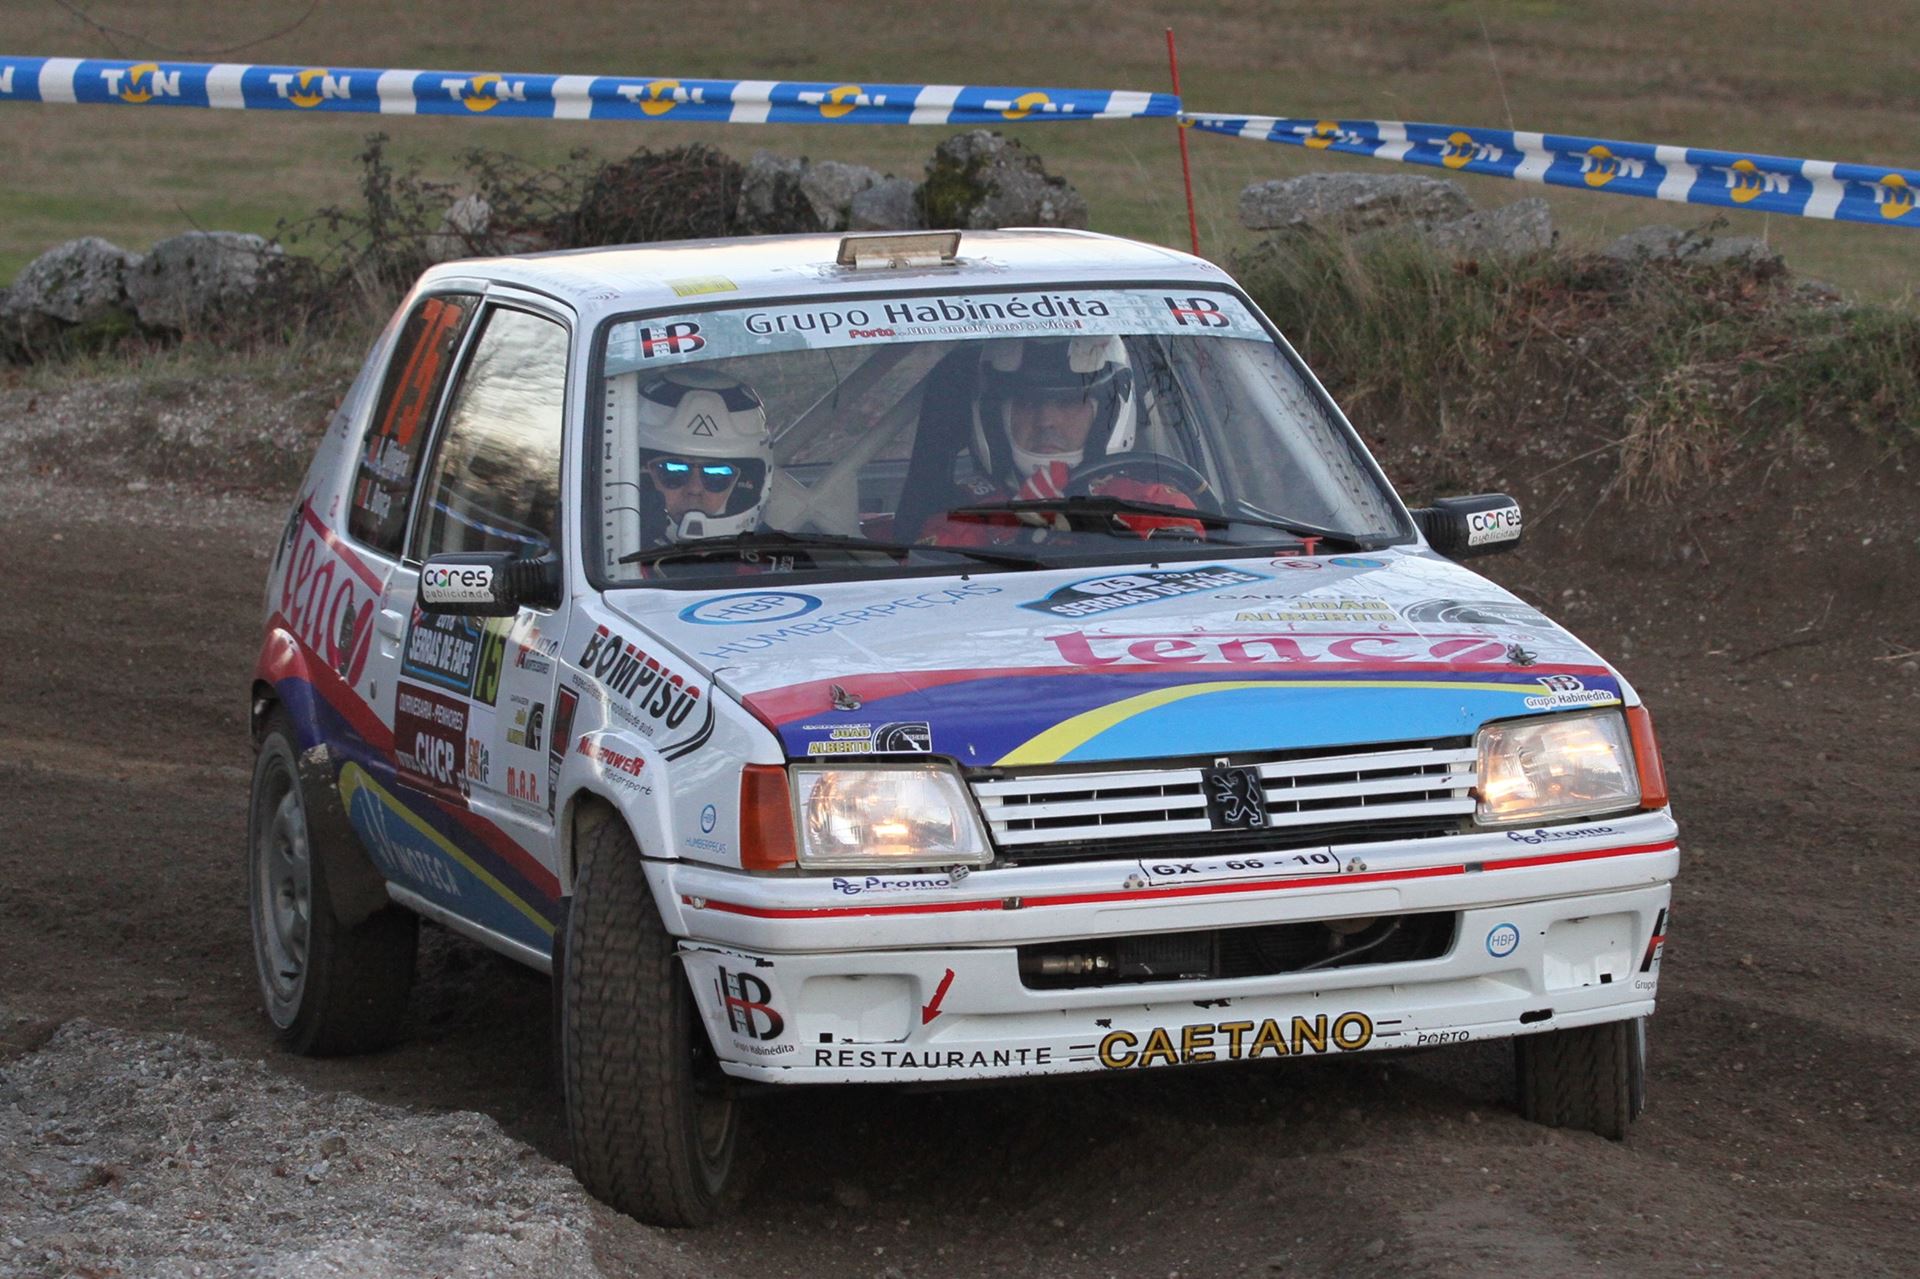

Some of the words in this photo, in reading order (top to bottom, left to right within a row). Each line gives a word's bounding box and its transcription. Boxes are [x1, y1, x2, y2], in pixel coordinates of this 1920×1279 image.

[746, 304, 869, 336] Grupo
[885, 294, 1110, 325] Habinédita
[849, 328, 897, 342] Porto
[1472, 509, 1521, 531] cores
[424, 568, 488, 588] cores
[1050, 587, 1161, 617] SERRAS
[1155, 580, 1190, 597] DE
[1186, 571, 1261, 589] FAFE
[703, 595, 786, 620] HBP
[1235, 612, 1398, 622] ALBERTO
[579, 623, 701, 730] BOMPISO
[1526, 696, 1557, 708] Grupo
[1558, 690, 1613, 704] Habinédita
[810, 741, 871, 753] ALBERTO
[1152, 862, 1200, 877] GX
[1226, 858, 1264, 871] 66
[1293, 852, 1330, 865] 10
[865, 876, 951, 890] Promo
[1491, 933, 1516, 947] HBP
[1634, 980, 1656, 993] Grupo
[1098, 1011, 1374, 1069] CAETANO
[1416, 1030, 1470, 1047] PORTO
[815, 1047, 1053, 1068] RESTAURANTE
